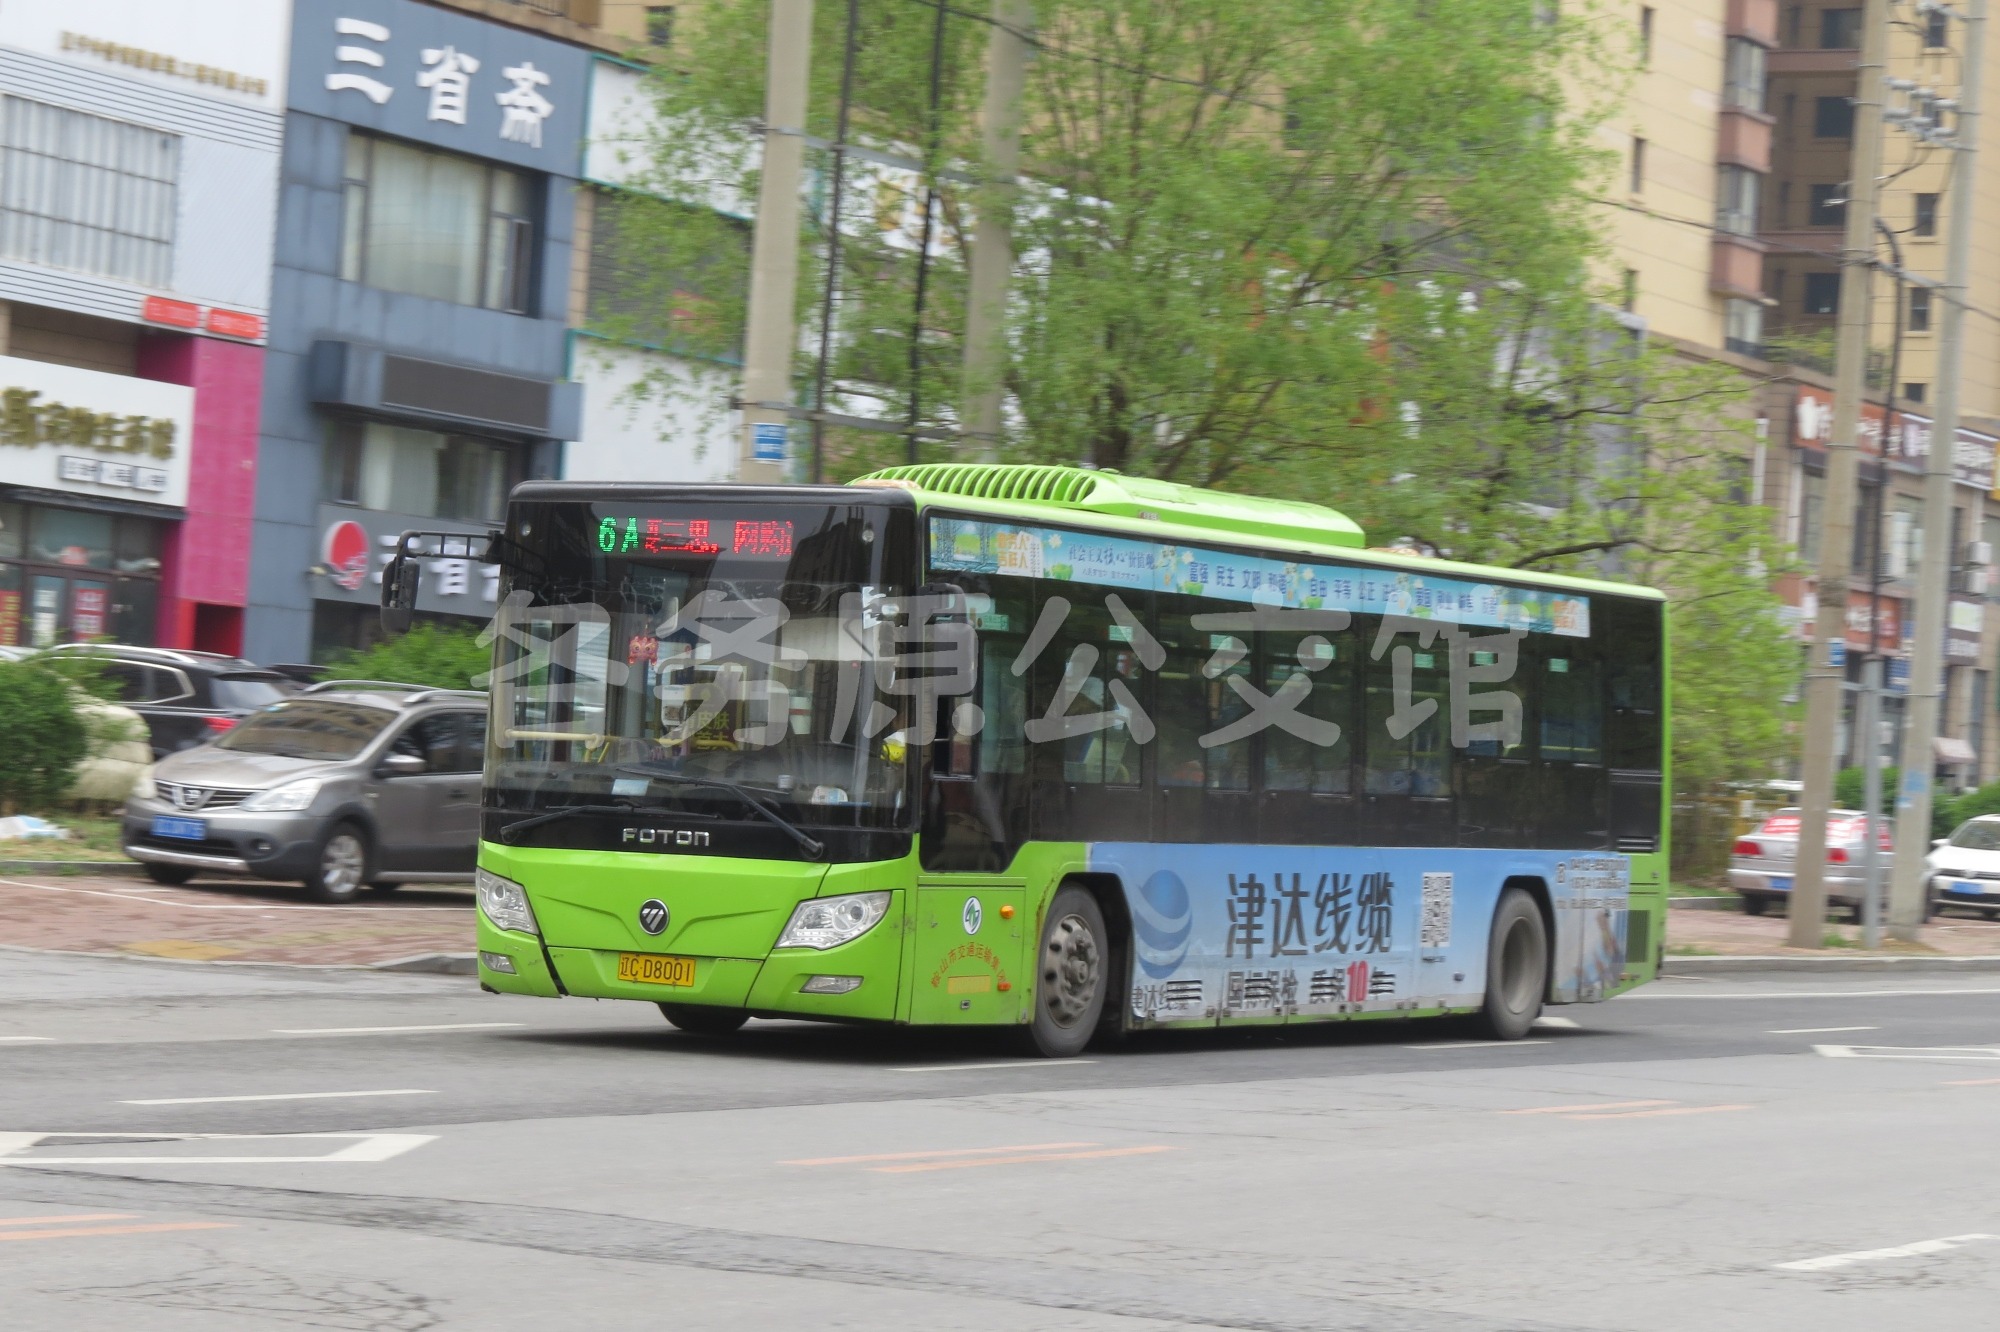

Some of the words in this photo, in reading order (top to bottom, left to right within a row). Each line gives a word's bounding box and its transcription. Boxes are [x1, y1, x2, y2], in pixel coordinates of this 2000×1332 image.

[325, 17, 554, 149] 三省斋
[371, 532, 501, 602] 三省
[599, 516, 639, 553] 6A
[622, 828, 710, 847] FOTON
[1226, 872, 1394, 958] 津达线缆
